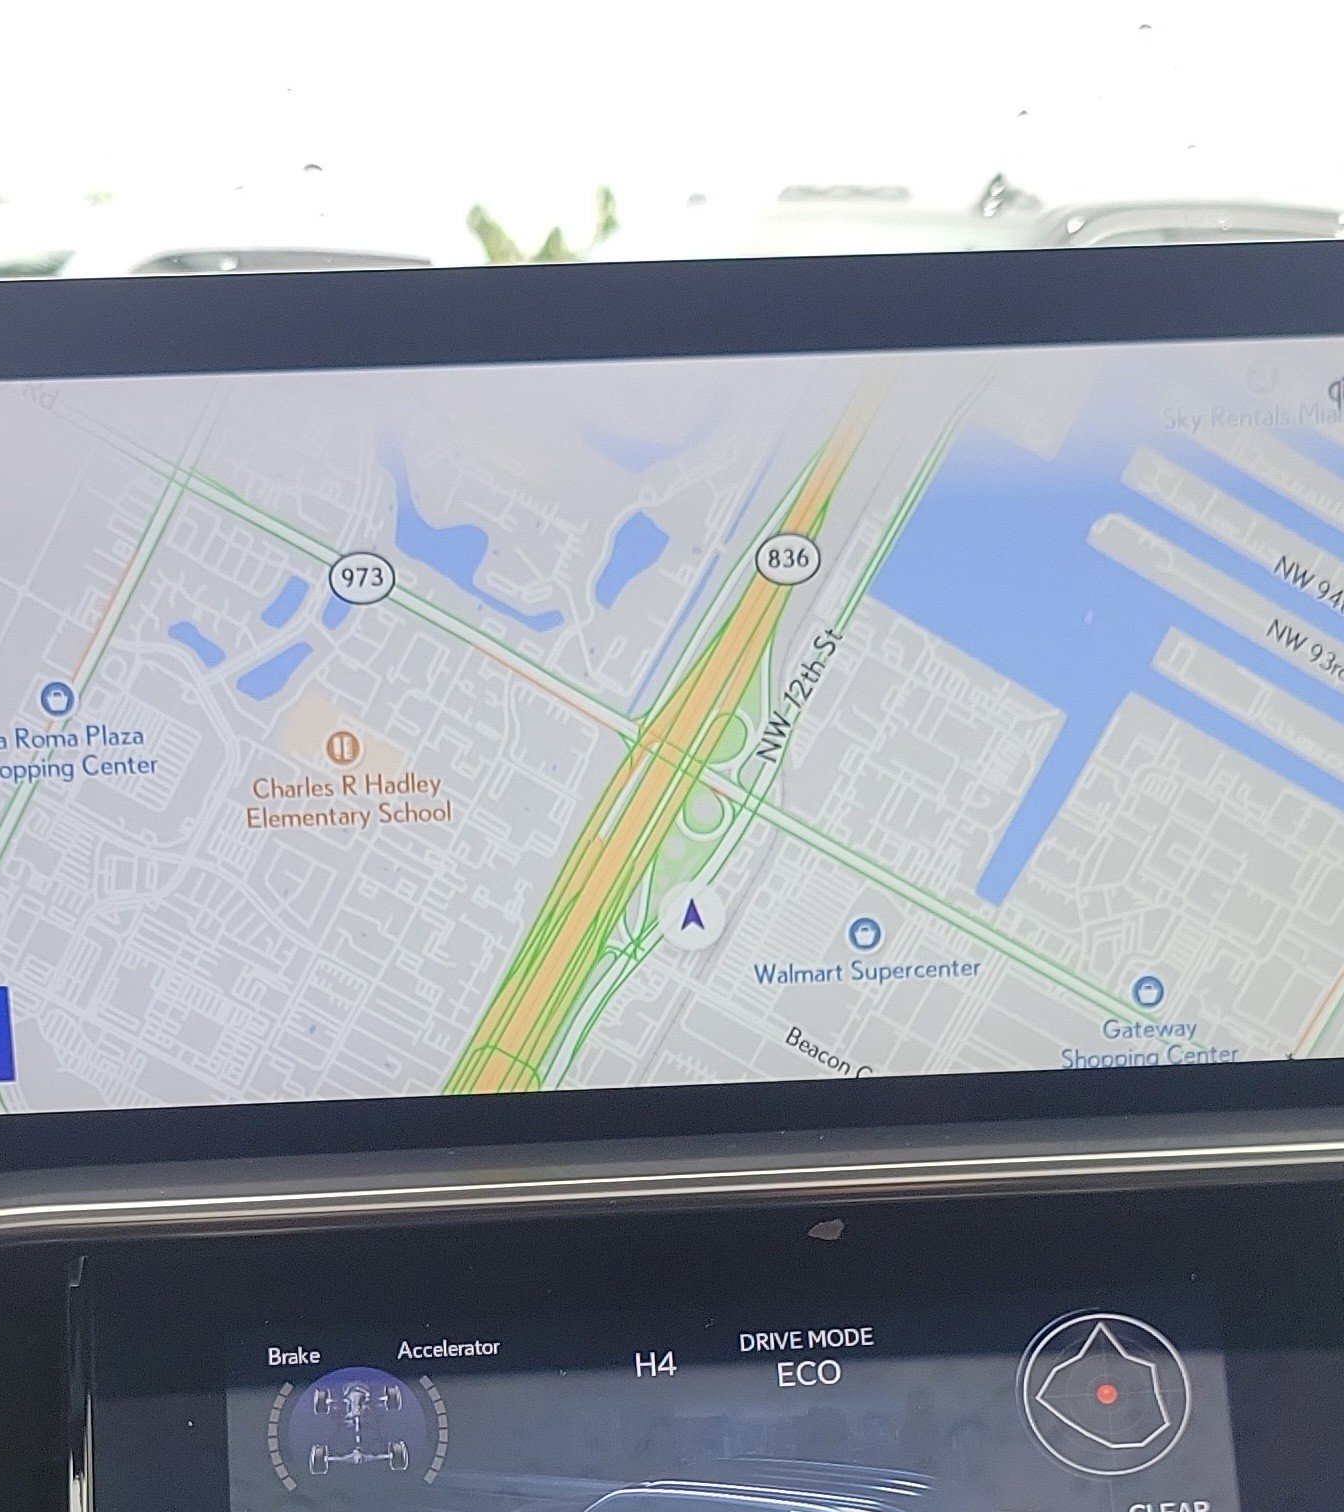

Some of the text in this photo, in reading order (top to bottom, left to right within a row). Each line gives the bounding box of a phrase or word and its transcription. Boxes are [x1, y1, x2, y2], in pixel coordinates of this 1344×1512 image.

[1163, 406, 1202, 432] Sky
[1210, 404, 1290, 428] Rentals
[768, 548, 810, 570] 836
[341, 567, 384, 587] 973
[1274, 556, 1315, 590] NW
[1266, 619, 1308, 652] NW
[756, 629, 843, 763] NW 12th St
[15, 727, 78, 749] Roma
[86, 725, 144, 747] Plaza
[82, 754, 158, 776] Center
[253, 772, 441, 799] Charles R Hadley
[247, 800, 452, 830] Elementary School
[754, 960, 981, 985] Walmart Supercenter
[1102, 1019, 1197, 1040] Gateway
[785, 1026, 851, 1075] Beacon
[1167, 1044, 1240, 1065] Center
[397, 1338, 500, 1360] Accelerator
[740, 1327, 874, 1352] DRIVE MODE
[268, 1346, 320, 1366] Brake
[635, 1351, 678, 1378] H4
[778, 1362, 841, 1387] ECO
